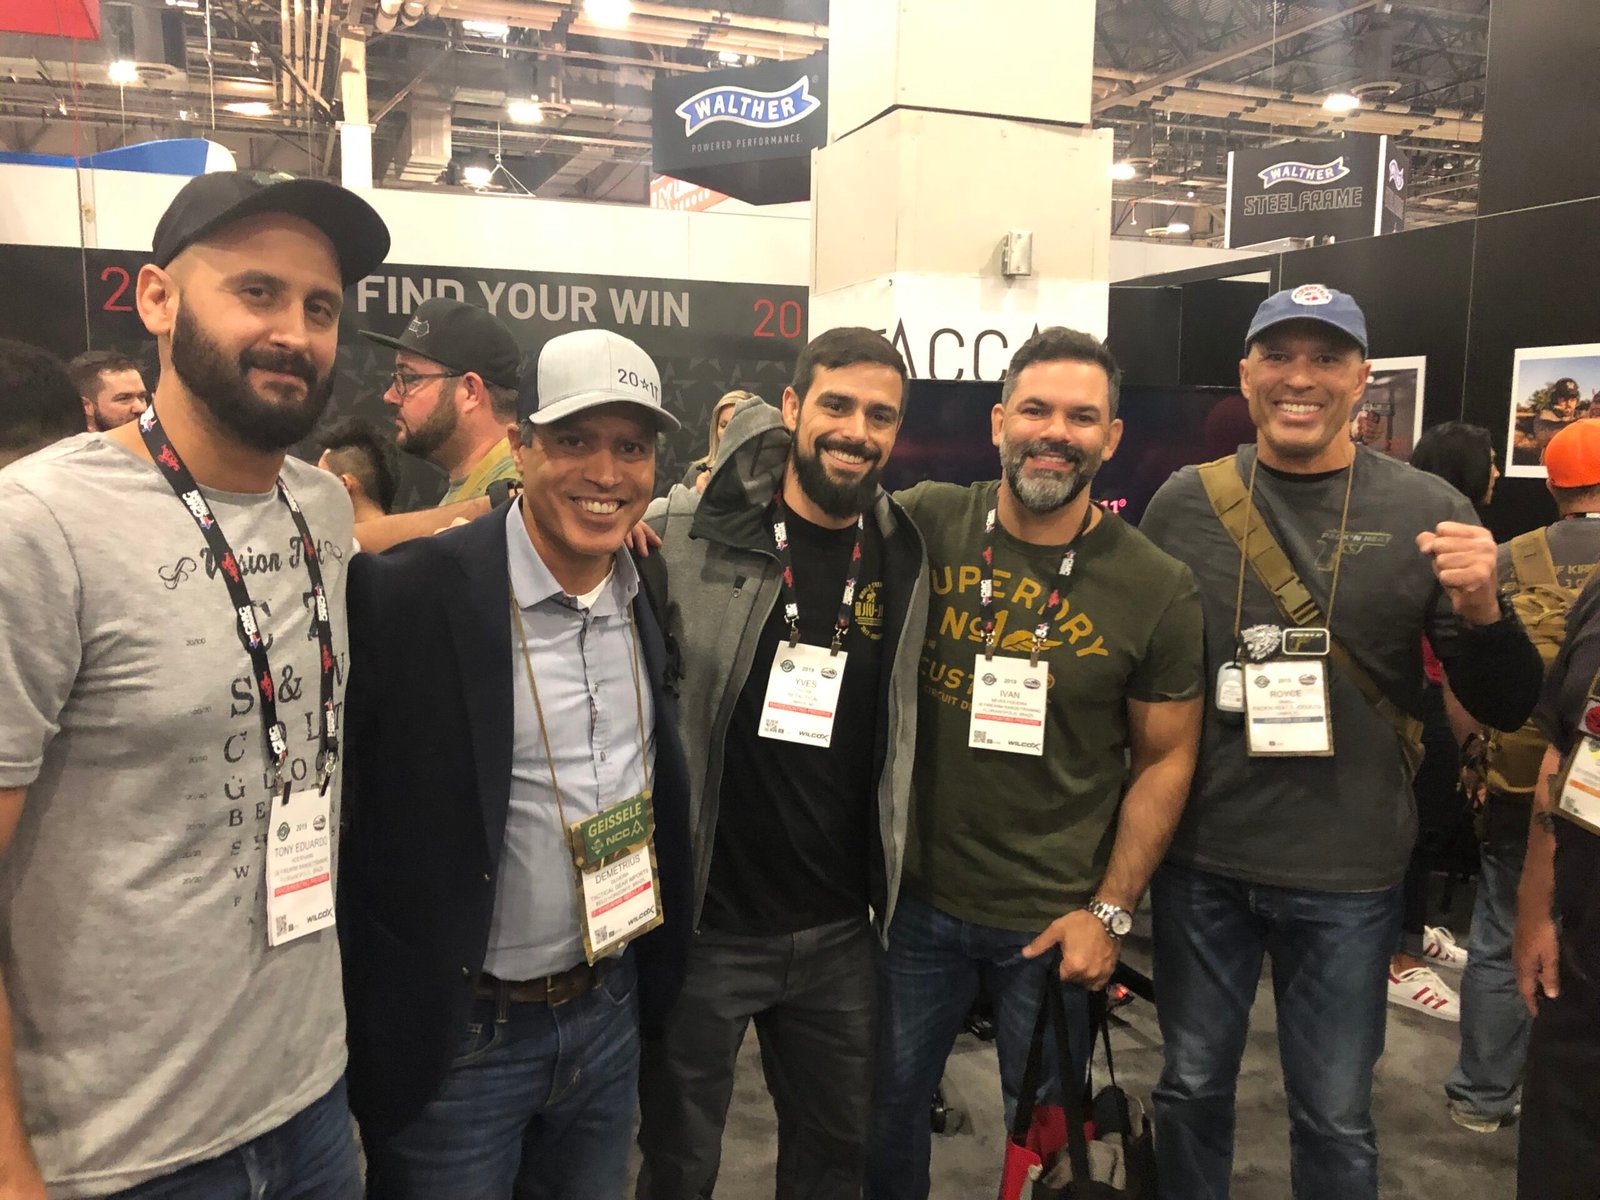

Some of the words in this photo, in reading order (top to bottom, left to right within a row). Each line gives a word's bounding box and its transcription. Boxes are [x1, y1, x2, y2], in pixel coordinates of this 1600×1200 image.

[694, 94, 796, 121] WALTHER
[691, 139, 732, 152] POWERED
[1269, 166, 1335, 181] WALTHER
[1244, 192, 1298, 216] STEEL
[1300, 186, 1363, 212] FRAME
[478, 279, 597, 326] YOUR
[608, 286, 690, 327] WIN
[752, 298, 801, 338] 20
[796, 678, 817, 689] YVES
[1000, 690, 1021, 698] IVAN
[1270, 690, 1303, 698] ROYCE
[799, 731, 830, 742] WILCOX
[1008, 740, 1041, 751] WILCOX
[588, 802, 642, 838] GEISSELE
[274, 843, 294, 858] TONY
[295, 836, 328, 853] EDUARDO
[595, 854, 641, 884] DEMETRIUS
[307, 907, 334, 923] WILCOX
[628, 905, 655, 926] WILCOX
